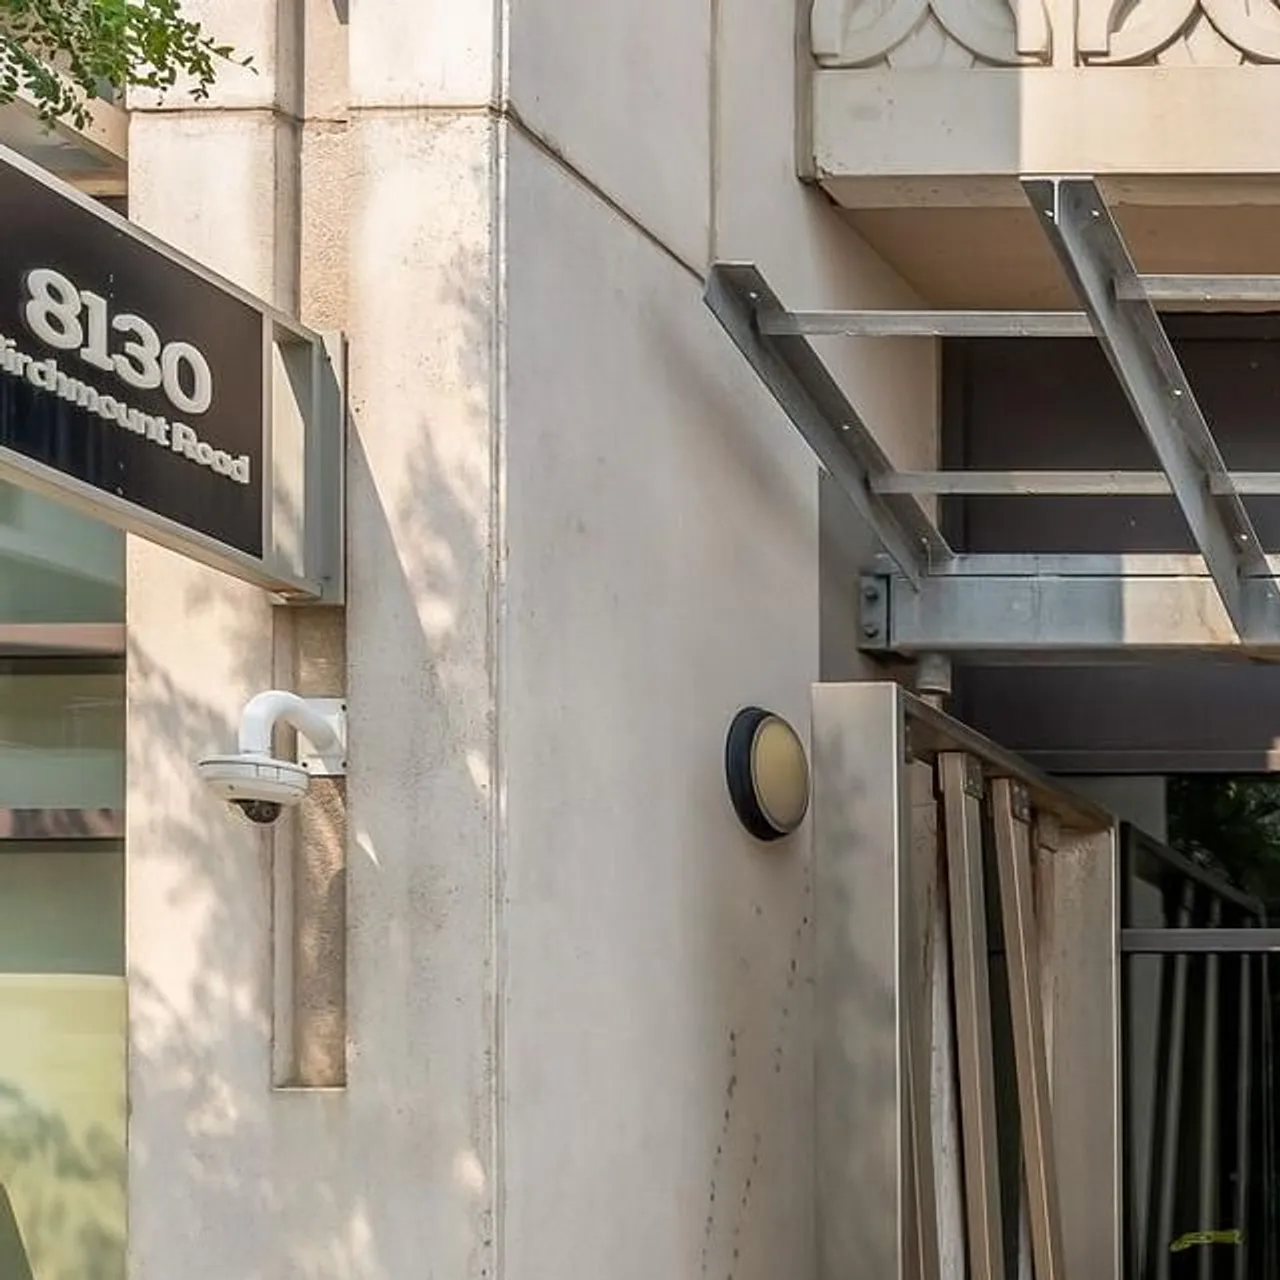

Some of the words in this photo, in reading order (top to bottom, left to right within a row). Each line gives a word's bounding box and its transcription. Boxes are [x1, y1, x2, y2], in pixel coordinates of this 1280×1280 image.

[0, 333, 170, 447] irchmount
[171, 421, 250, 484] Road
[26, 269, 212, 414] 8130
